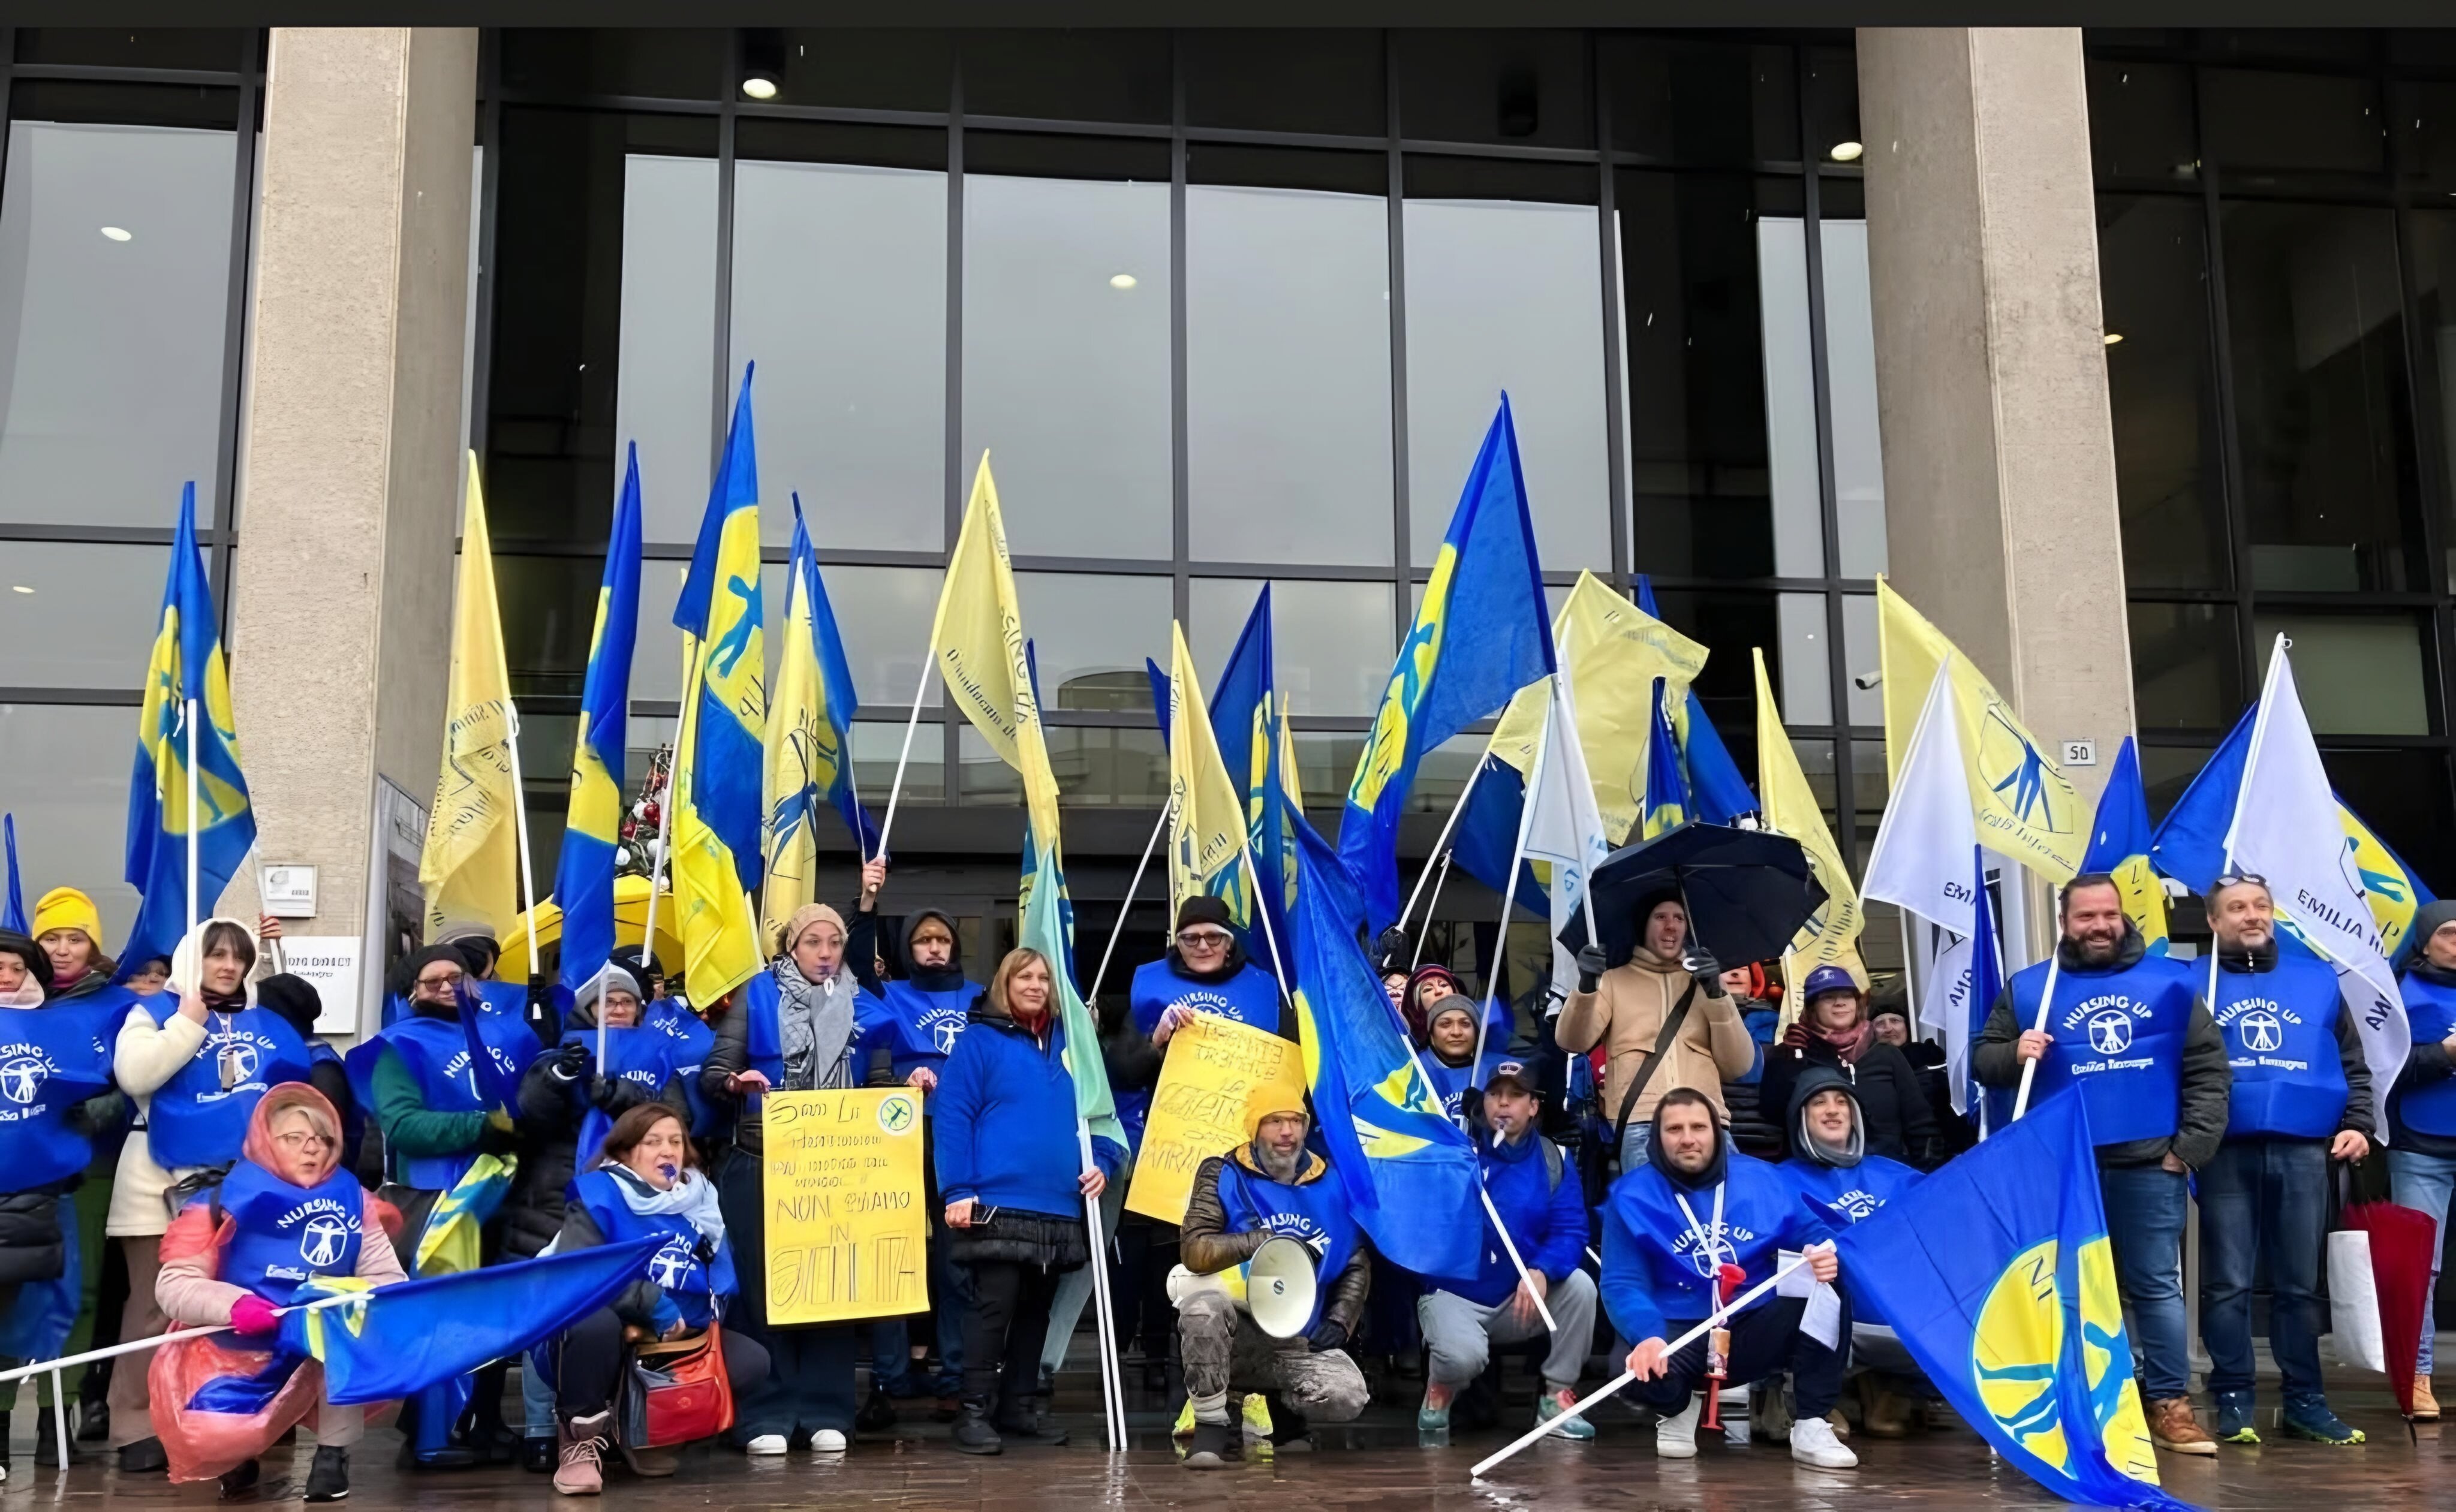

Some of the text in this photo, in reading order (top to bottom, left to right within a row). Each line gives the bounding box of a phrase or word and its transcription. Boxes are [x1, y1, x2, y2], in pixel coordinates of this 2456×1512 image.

[2070, 746, 2088, 760] 50
[2298, 888, 2361, 939] EMILIA
[2132, 1001, 2153, 1018] UP
[2282, 1008, 2302, 1024] UP
